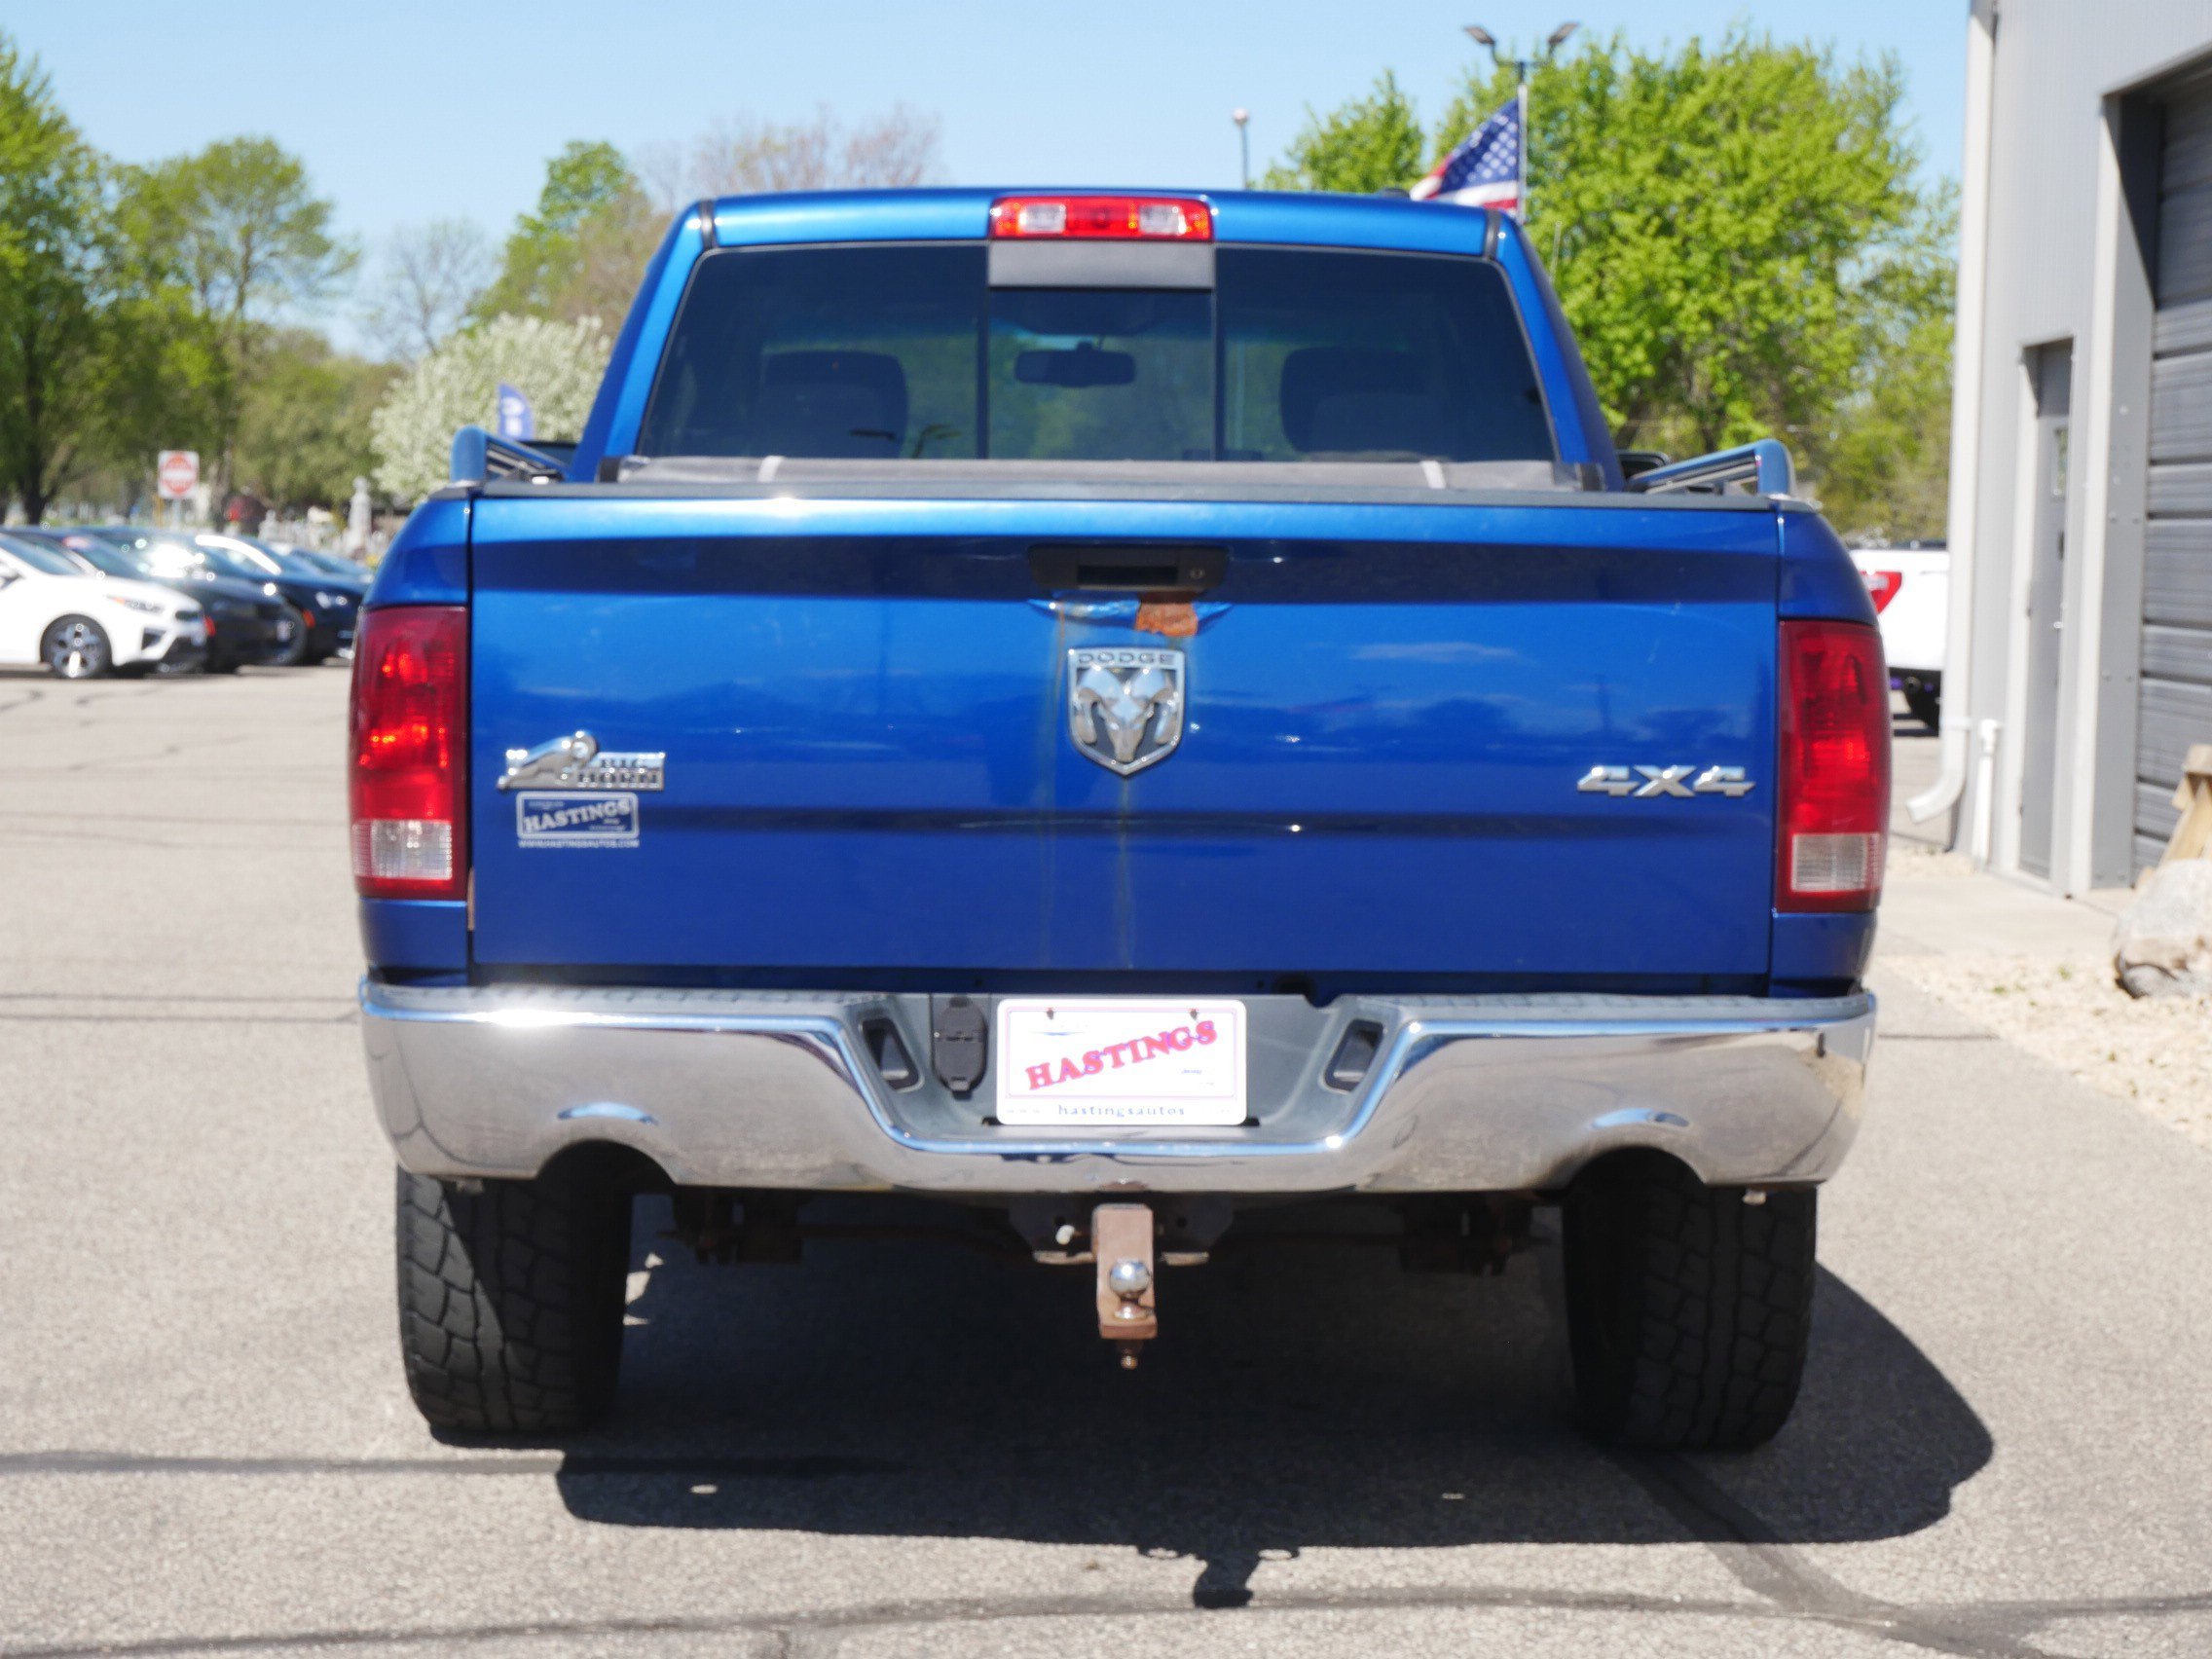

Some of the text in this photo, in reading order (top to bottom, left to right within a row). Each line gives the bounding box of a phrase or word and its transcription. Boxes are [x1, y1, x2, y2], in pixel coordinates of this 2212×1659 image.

[1079, 652, 1174, 665] DODGE
[523, 798, 631, 832] HASTINGS
[1025, 1020, 1217, 1090] HASTINGS
